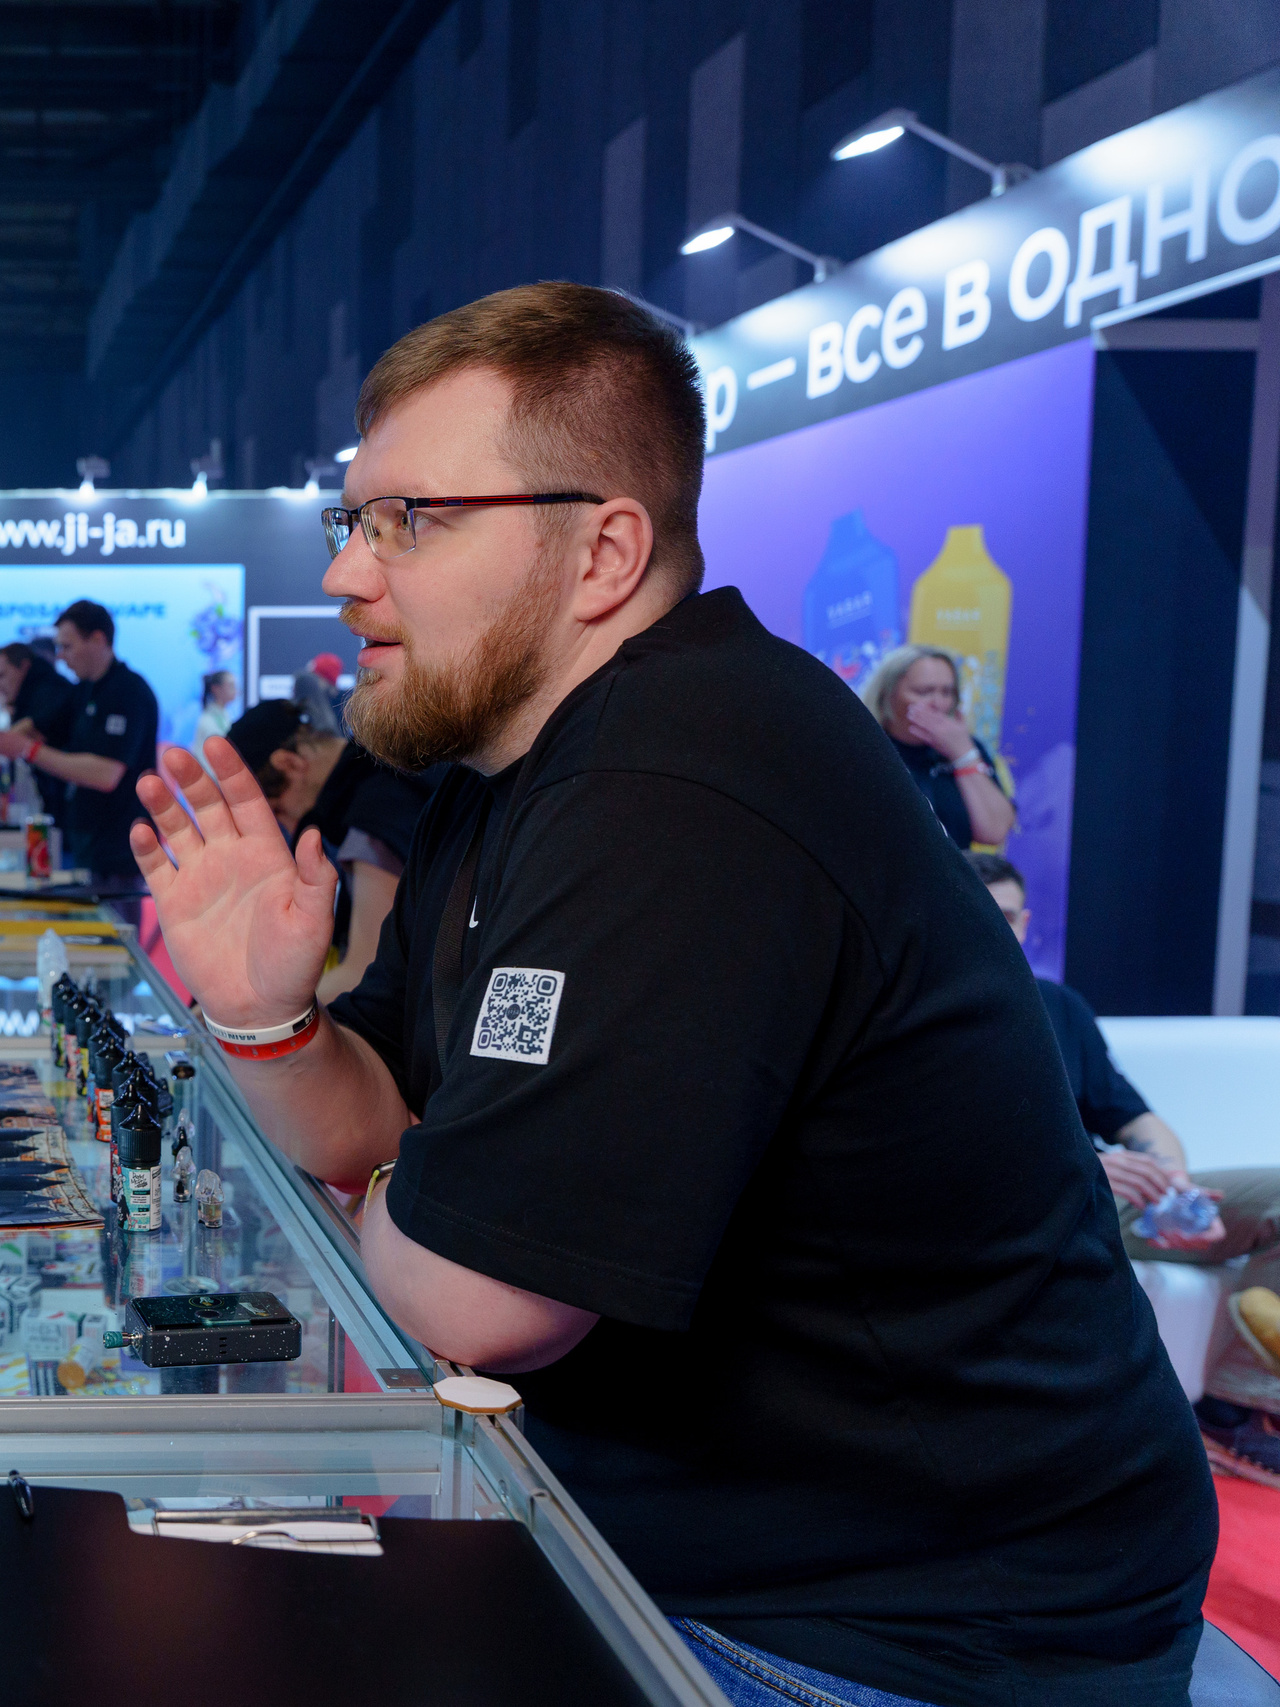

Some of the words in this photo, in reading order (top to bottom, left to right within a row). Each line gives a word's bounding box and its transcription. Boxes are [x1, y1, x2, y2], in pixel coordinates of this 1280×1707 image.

[806, 286, 928, 400] все
[942, 259, 991, 351] в
[227, 1033, 257, 1041] MAIN
